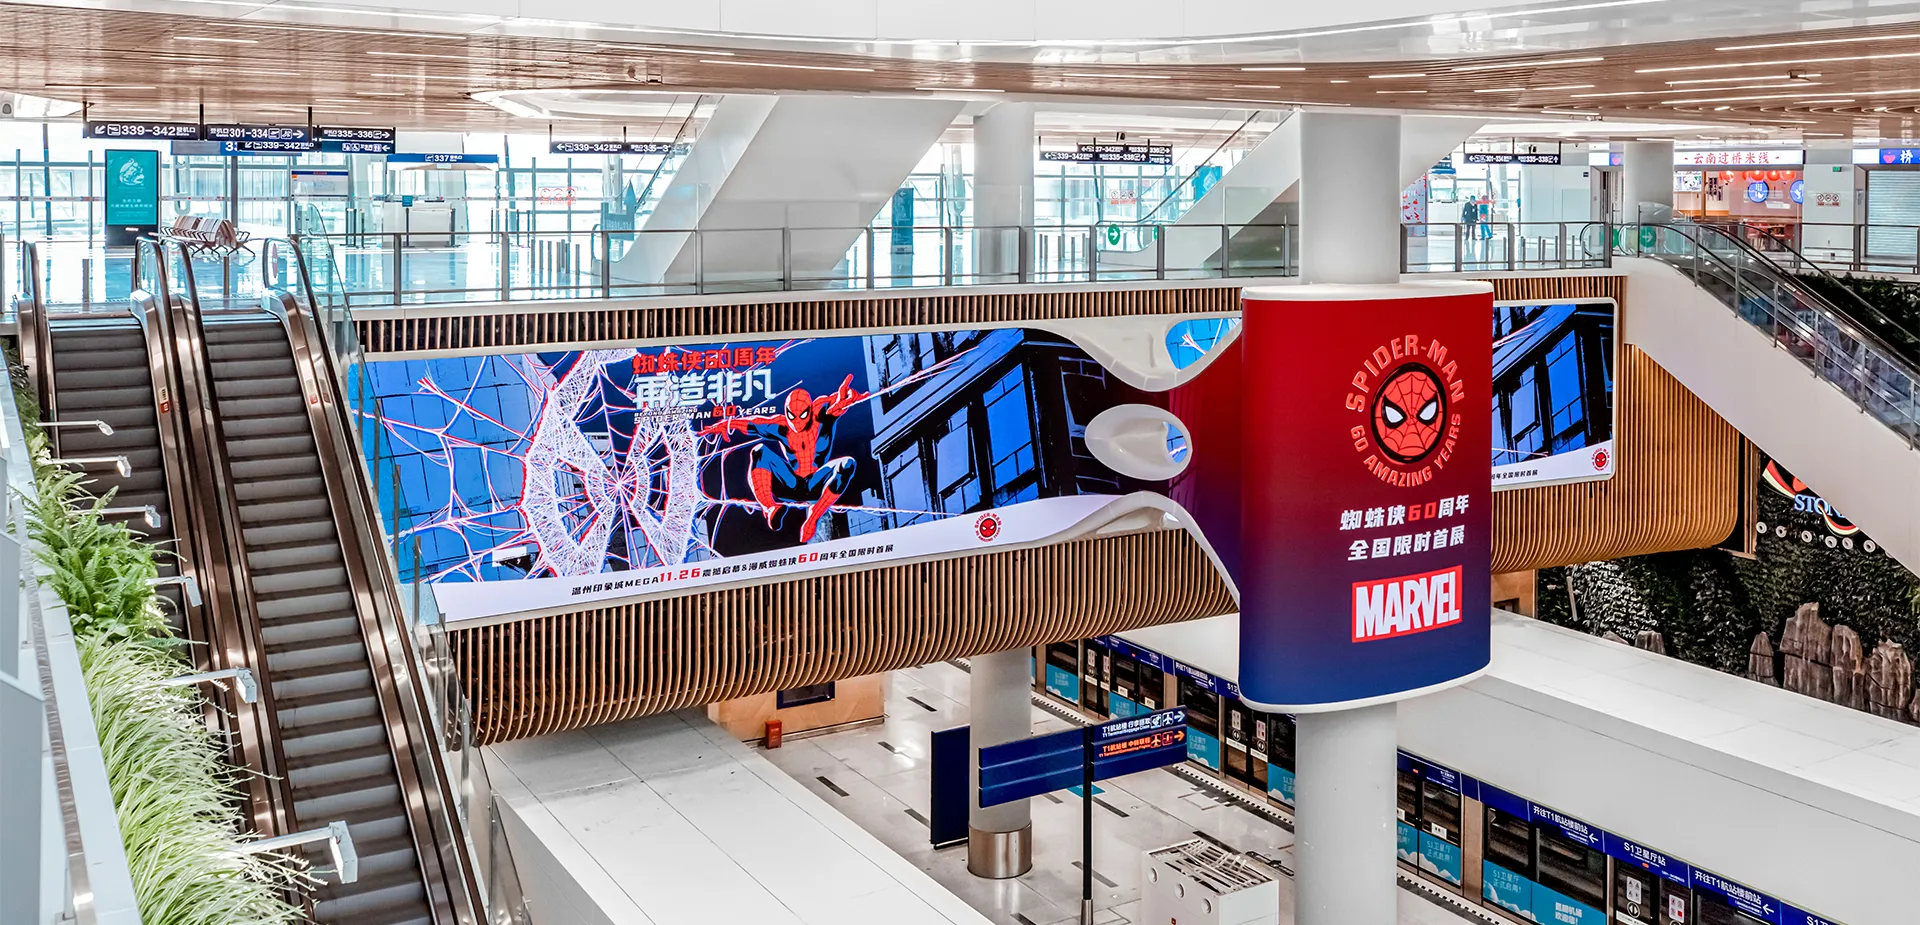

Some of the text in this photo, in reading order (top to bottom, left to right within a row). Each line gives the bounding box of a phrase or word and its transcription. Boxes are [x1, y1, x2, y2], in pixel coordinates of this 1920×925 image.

[121, 125, 176, 136] 339-342
[229, 128, 268, 138] 301-334
[573, 143, 608, 151] 339-342
[1693, 152, 1770, 165] 云南过桥米线
[632, 347, 778, 375] 蜘蛛侠60周年
[1345, 334, 1465, 413] SPIDER-MAN
[632, 368, 778, 411] 再造非凡
[712, 405, 737, 417] 60
[738, 406, 777, 417] YEARS
[1350, 413, 1462, 488] 60 AMAZING YEARS
[1339, 494, 1470, 531] 蜘蛛侠60周年
[1347, 524, 1466, 561] 全国限时首展
[1355, 571, 1461, 638] MARVEL
[1623, 841, 1667, 867] S1卫星厅站
[1695, 870, 1762, 906] 开往T1航站楼前站
